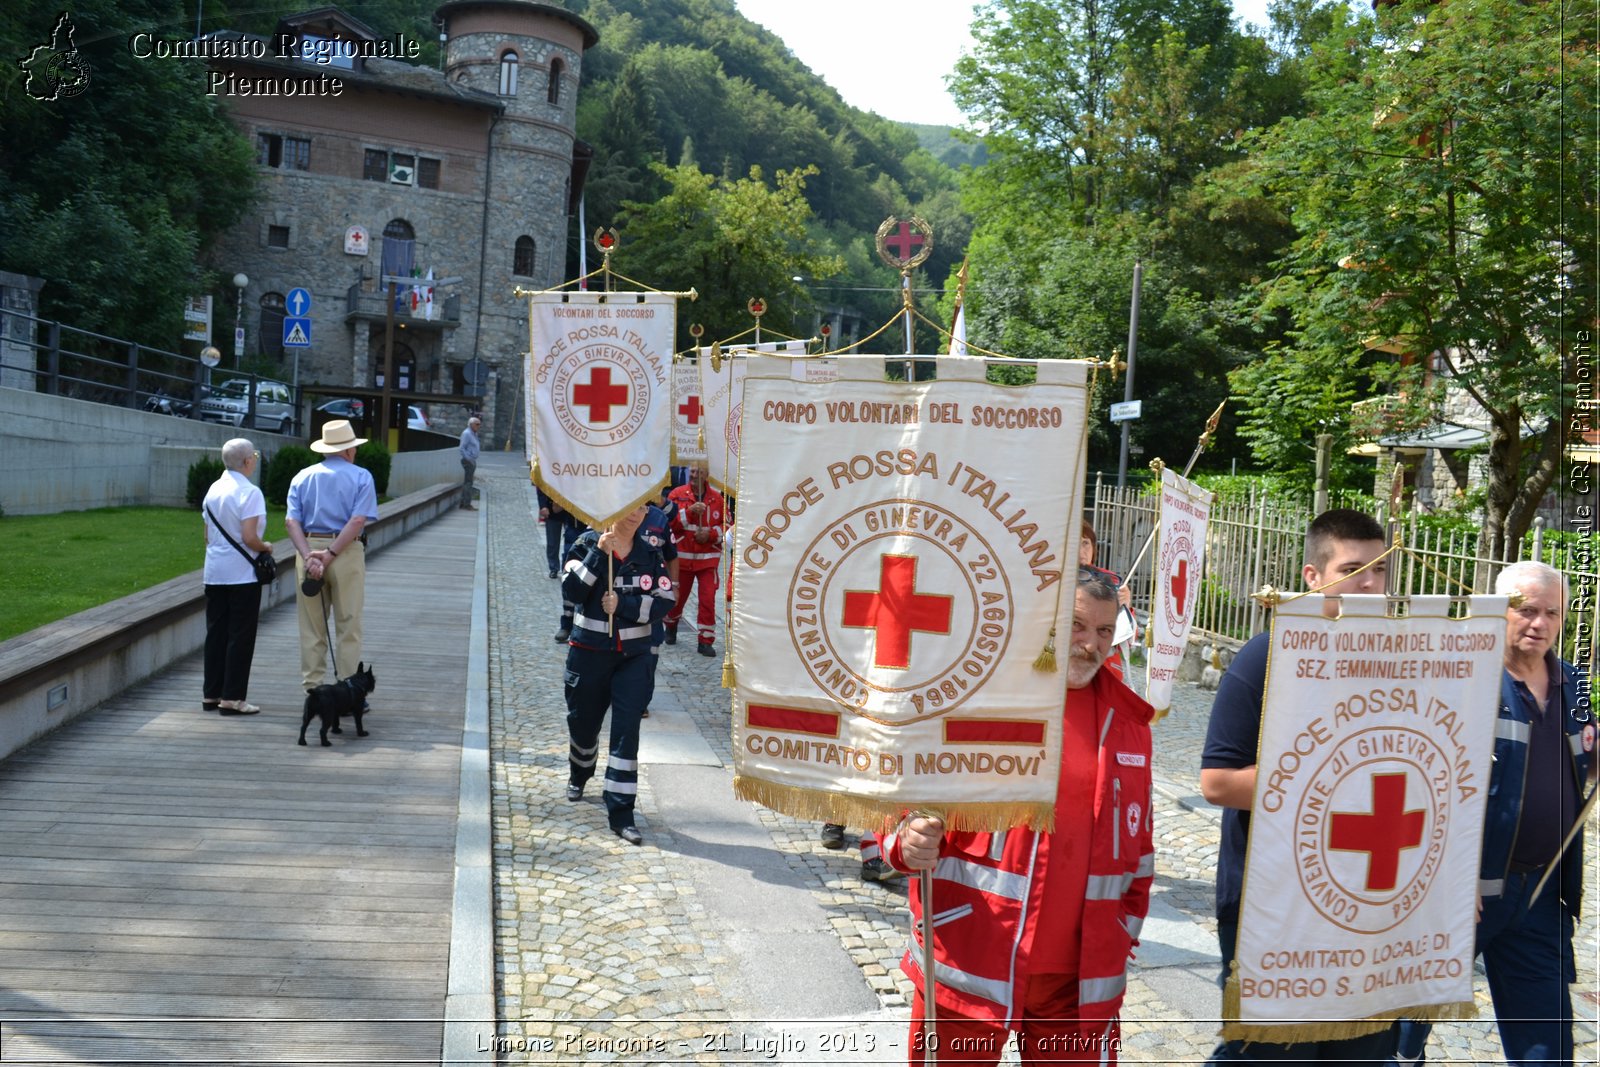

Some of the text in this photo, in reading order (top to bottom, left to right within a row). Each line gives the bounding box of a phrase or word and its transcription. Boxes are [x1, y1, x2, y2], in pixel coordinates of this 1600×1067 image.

[553, 308, 654, 319] VOLONTARI DEL SOCCORSO
[535, 324, 667, 387] CROCE ROSSA ITALIANA
[555, 347, 648, 440] CONVENZIONE DI GINEVRA 22 AGOSTO 1864
[763, 400, 816, 424] CORPO
[826, 401, 918, 424] VOLONTARI
[929, 403, 963, 424] DEL
[971, 405, 1062, 429] SOCCORSO
[552, 463, 652, 477] SAVIGLIANO
[743, 448, 1062, 592] CROCE ROSSA ITALIANA
[796, 506, 1006, 714] CONVENZIONE DI GINEVRA 22 AGOSTO 1864
[1281, 629, 1328, 650] CORPO
[1335, 632, 1409, 653] VOLONTARI
[1411, 633, 1434, 652] DEL
[1296, 658, 1330, 681] SEZ.
[1421, 660, 1474, 679] PIONIERI
[746, 733, 871, 772] COMITATO
[879, 753, 903, 776] DI
[1263, 717, 1333, 813] CROCE
[1334, 688, 1419, 728] ROSSA
[1300, 780, 1359, 923] CONVENZIONE
[1331, 750, 1350, 776] DI
[1357, 733, 1436, 770] GINEVRA
[1433, 769, 1449, 797] 22
[1260, 932, 1450, 971] COMITATO LOCALE DI
[1241, 957, 1463, 999] BORGO S. DALMAZZO
